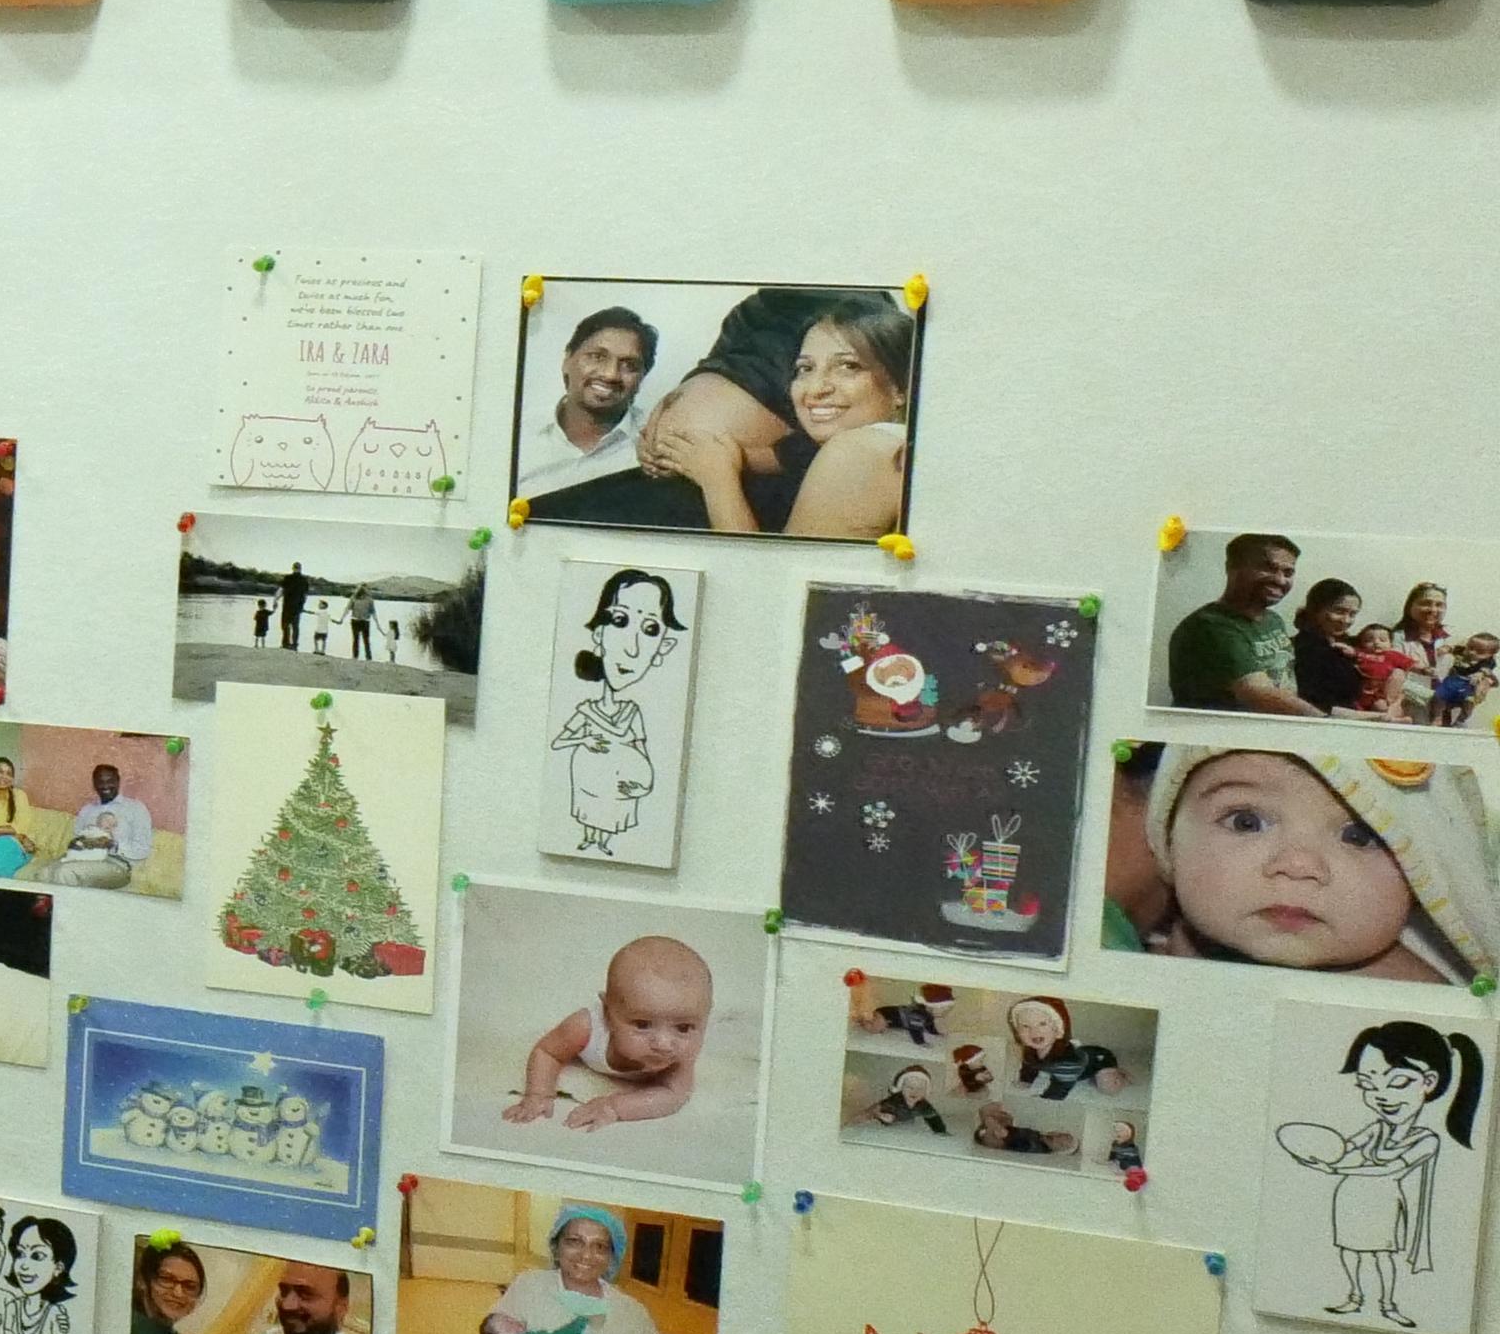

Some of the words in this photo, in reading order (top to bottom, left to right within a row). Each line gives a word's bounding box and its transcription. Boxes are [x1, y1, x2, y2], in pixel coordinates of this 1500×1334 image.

[300, 339, 324, 363] IRA
[332, 341, 345, 364] &
[352, 341, 389, 366] ZARA
